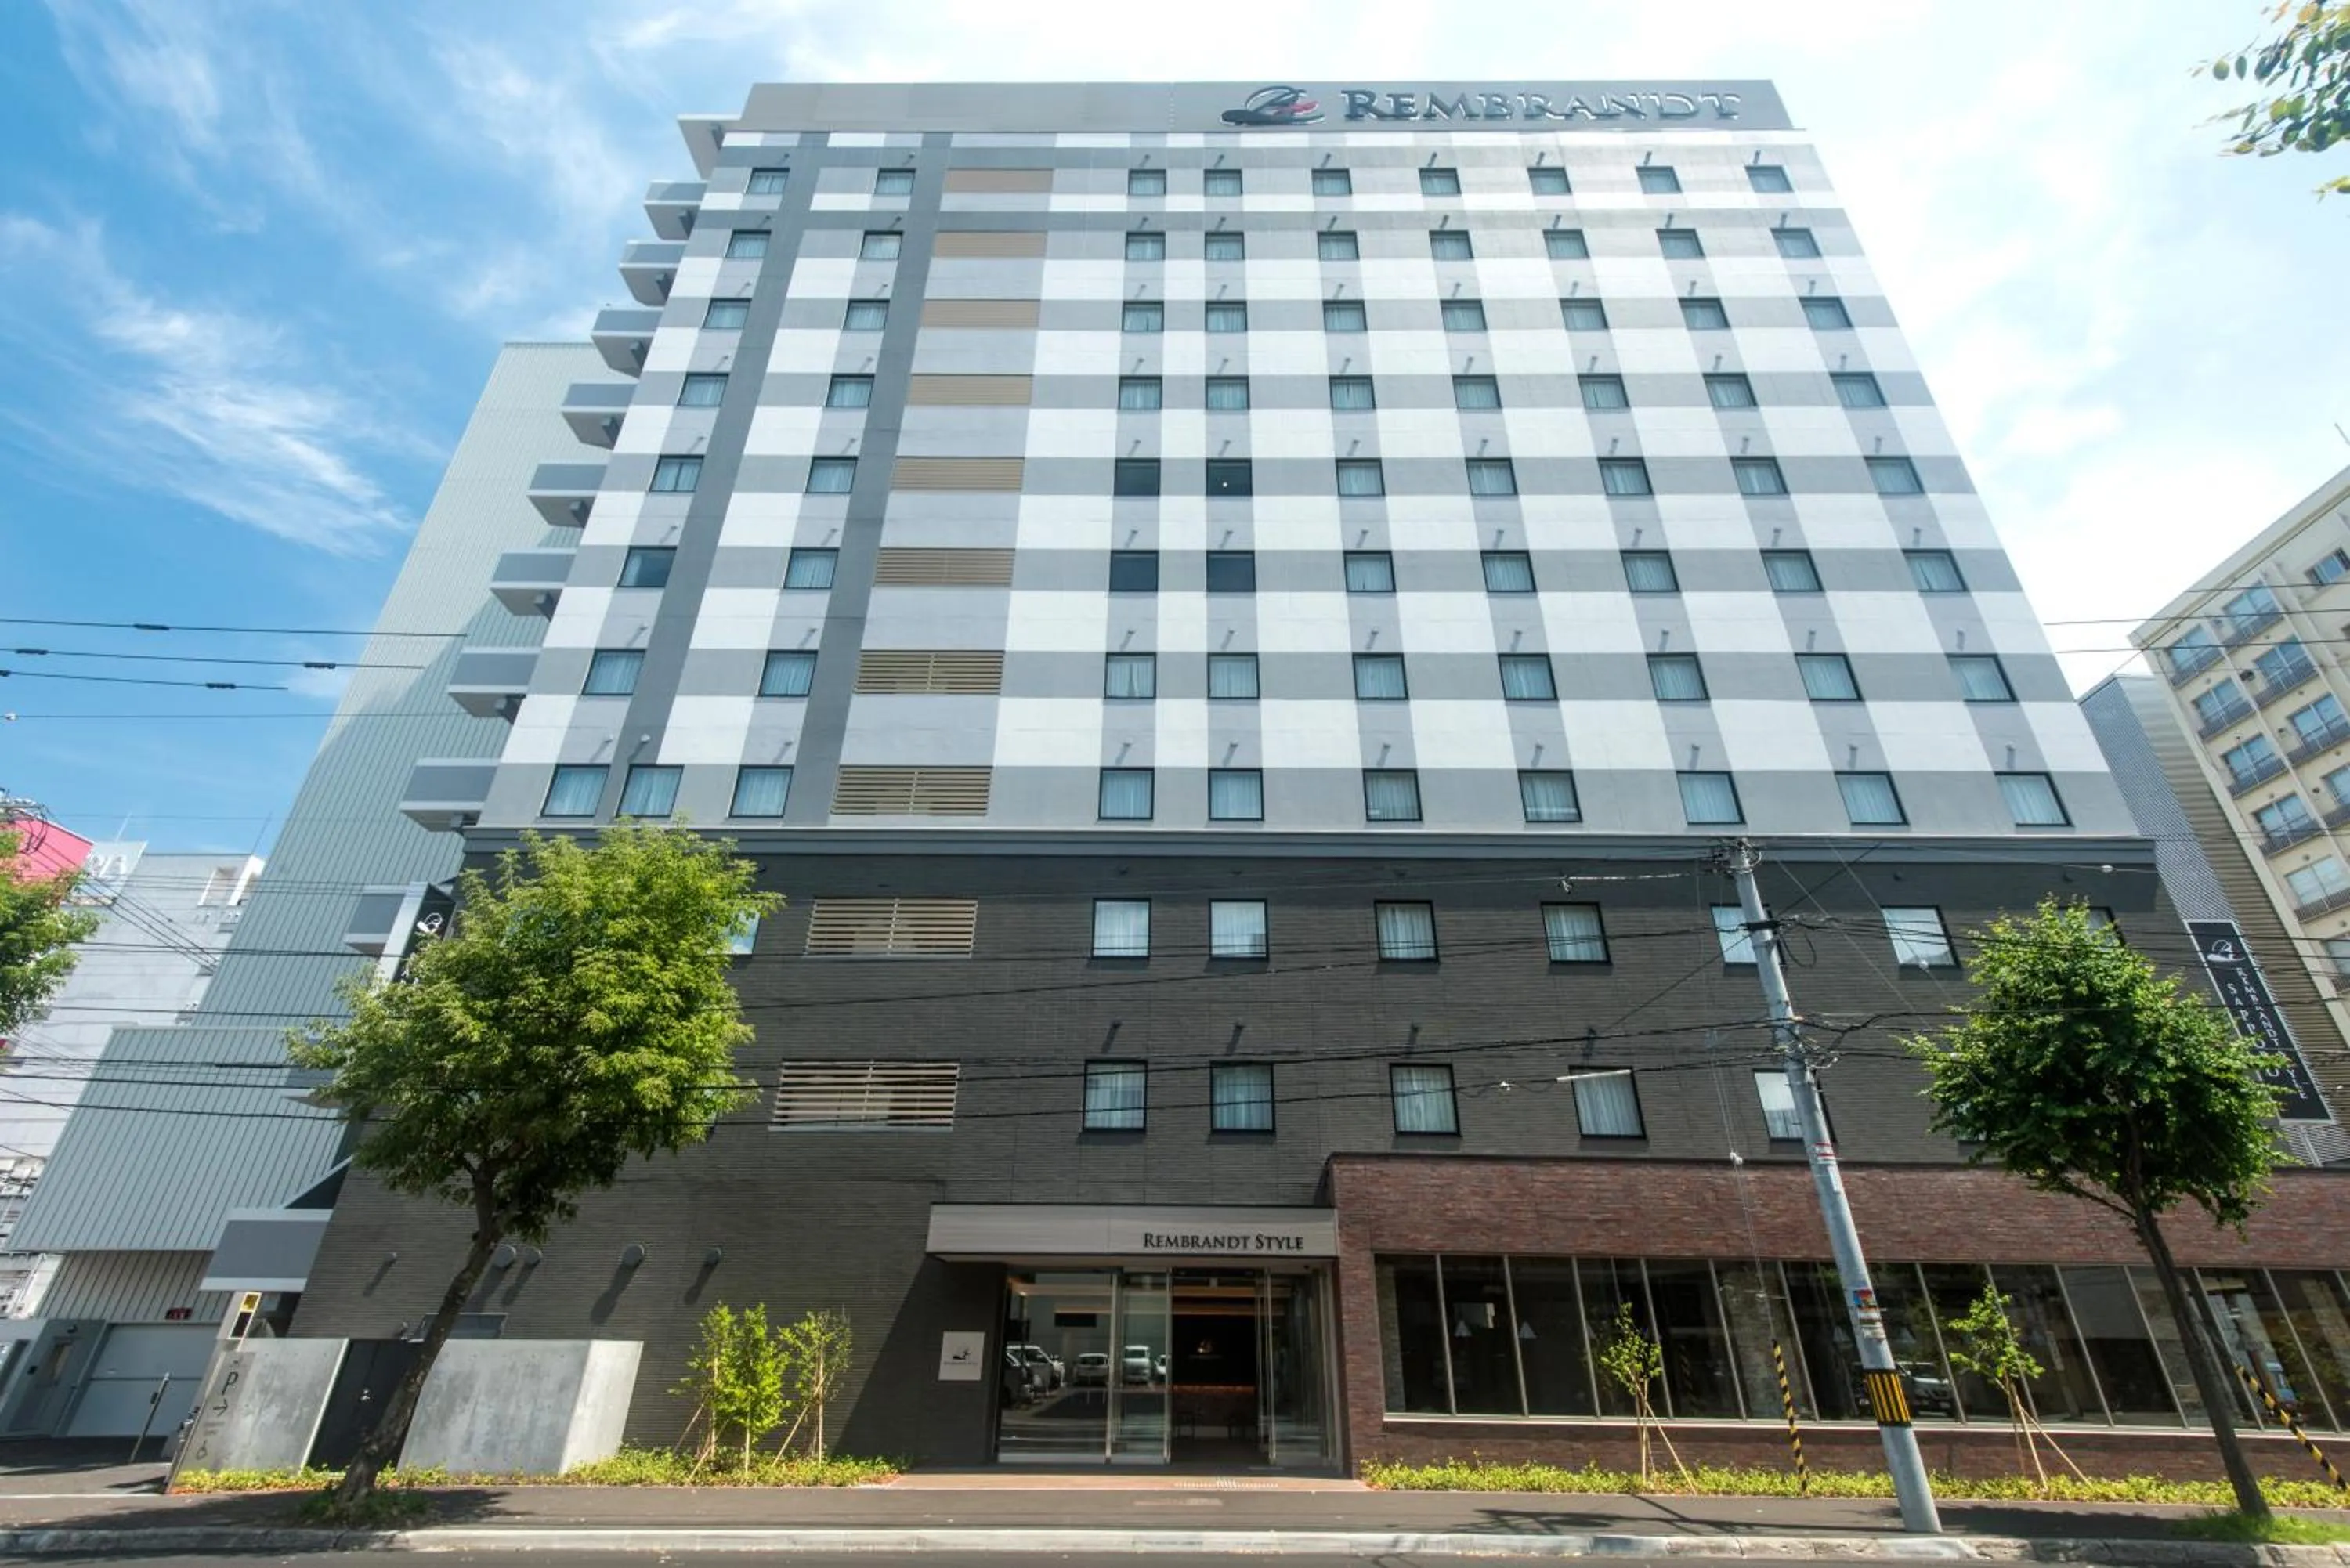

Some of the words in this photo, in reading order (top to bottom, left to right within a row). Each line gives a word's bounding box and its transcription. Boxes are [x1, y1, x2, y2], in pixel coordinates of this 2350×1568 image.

[1340, 90, 1741, 121] REMBRANDT
[1144, 1233, 1251, 1250] REMBRANDT
[1255, 1234, 1304, 1250] STYLE
